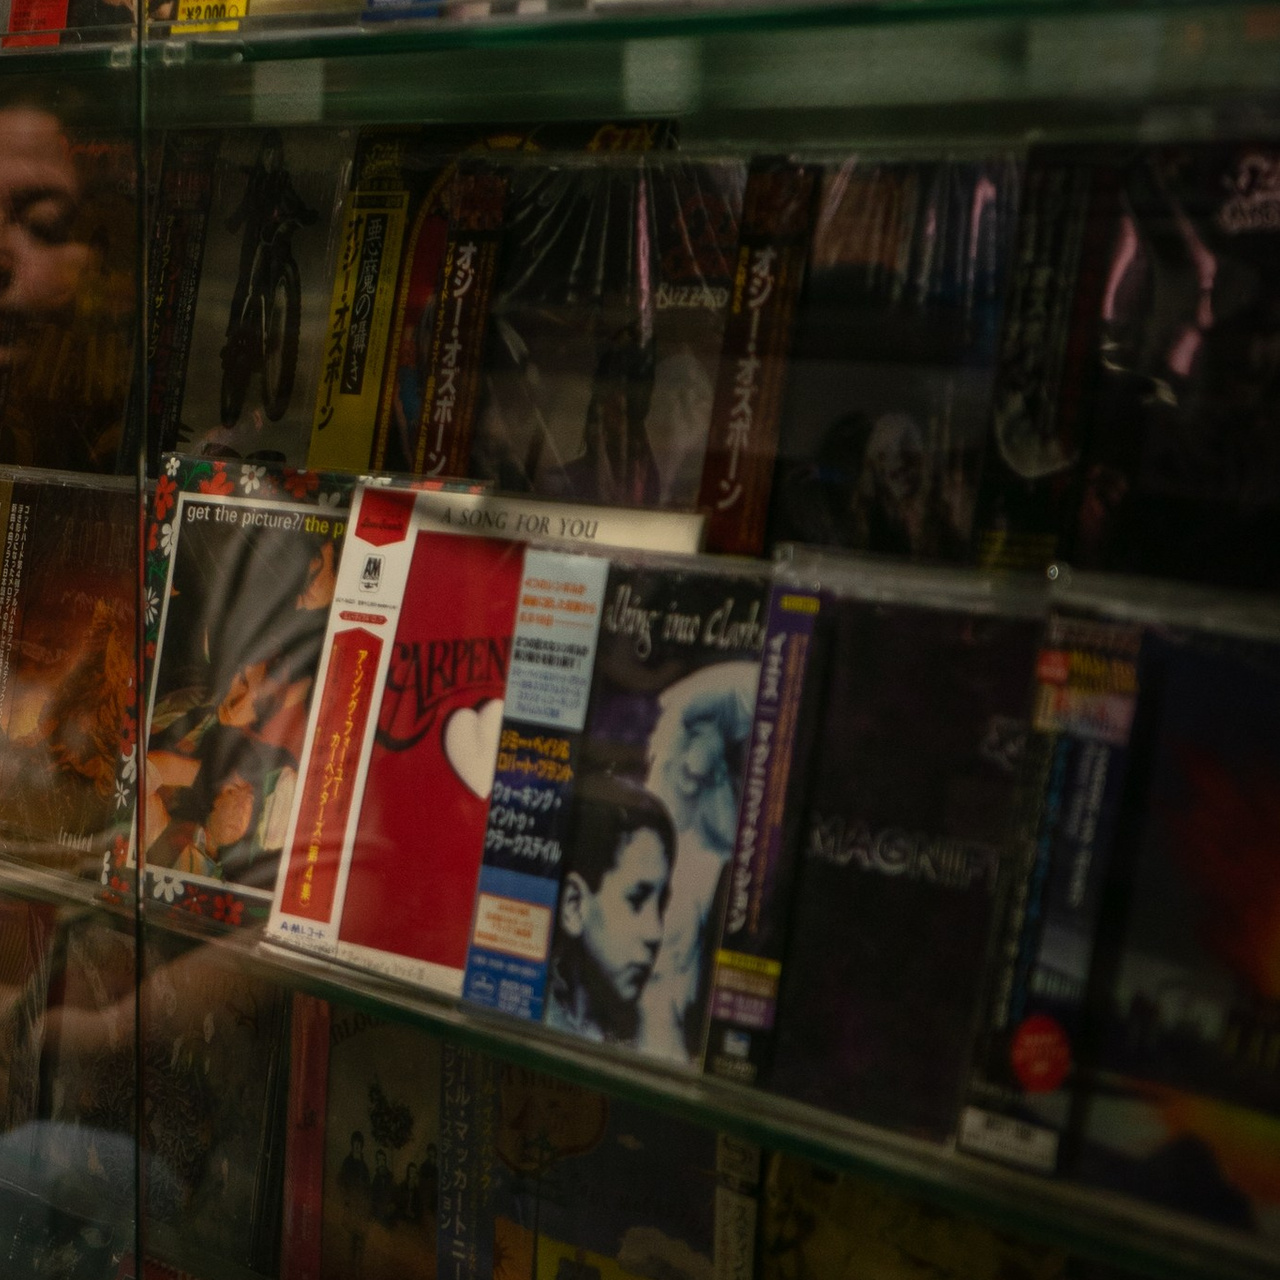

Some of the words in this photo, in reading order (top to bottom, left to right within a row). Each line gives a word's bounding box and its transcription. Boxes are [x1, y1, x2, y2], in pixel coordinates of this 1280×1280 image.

[316, 216, 364, 431] オジー・オズボーン
[425, 241, 477, 477] オジー・オズボーン
[716, 245, 774, 511] オジー・オズボーン
[186, 504, 212, 525] get
[215, 505, 238, 524] the
[442, 509, 455, 524] A
[458, 508, 509, 530] SONG
[515, 515, 550, 533] FOR
[559, 516, 600, 540] YOU
[332, 649, 369, 799] ア・ソング・フォー・ユー
